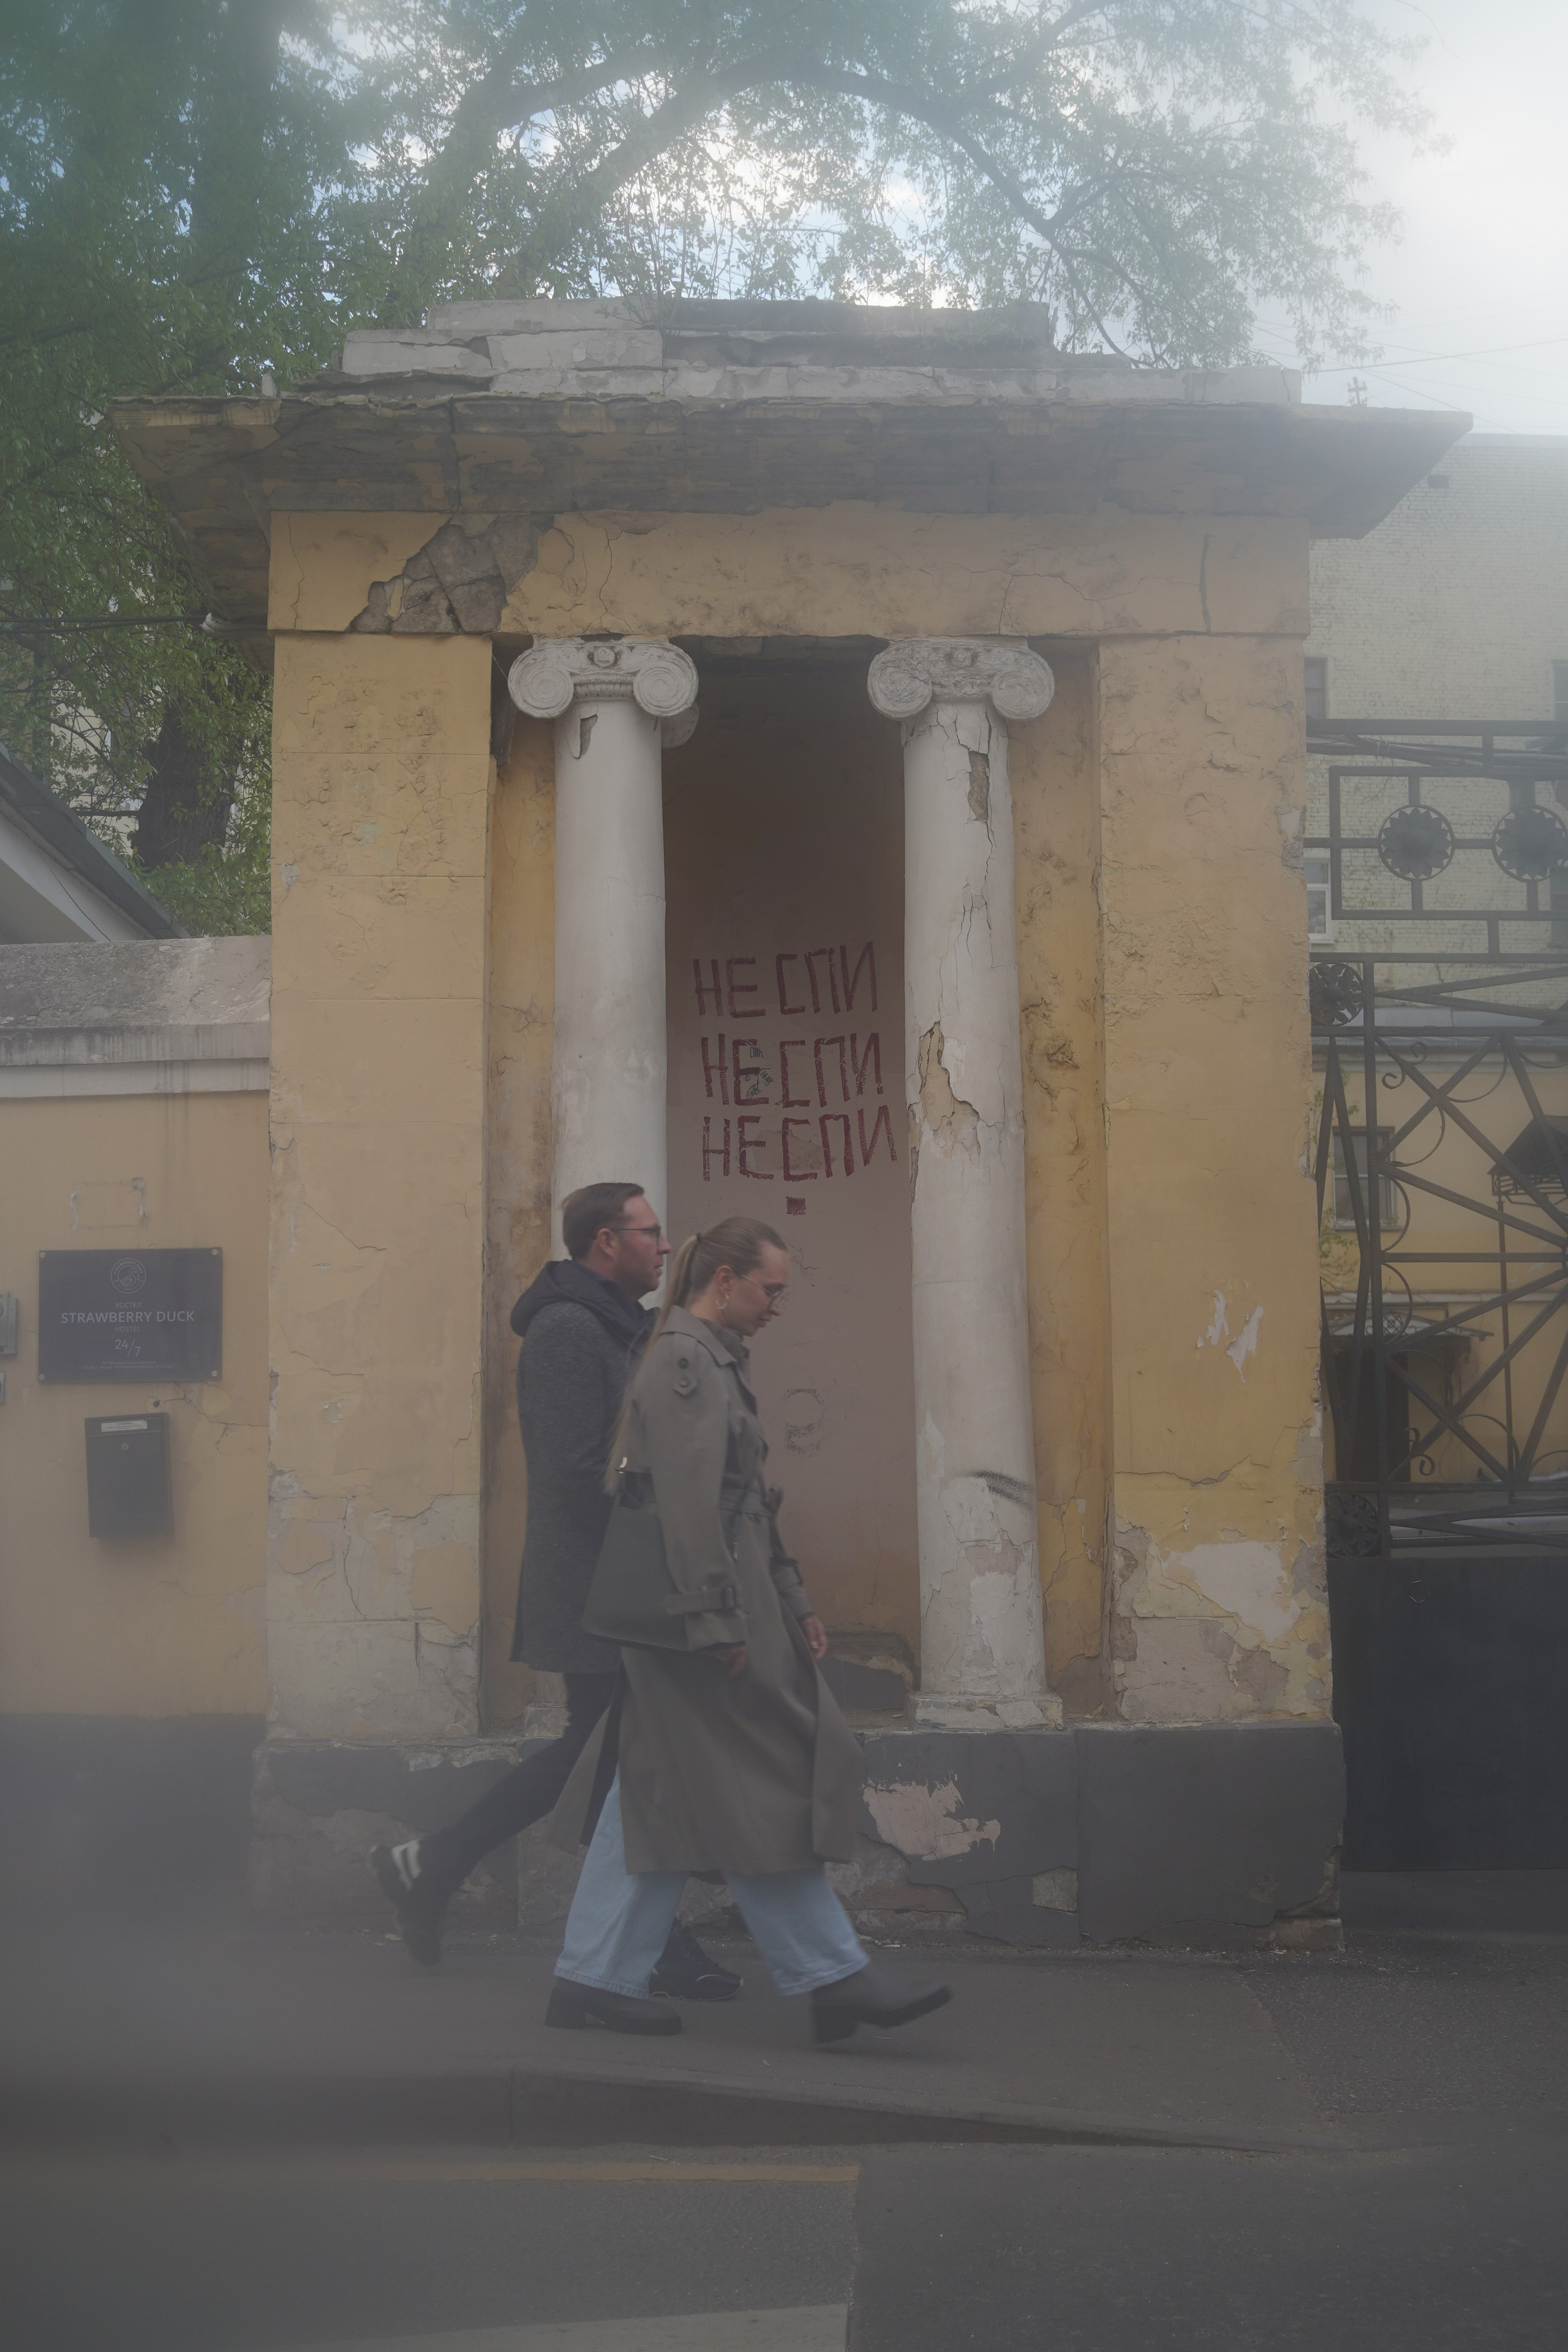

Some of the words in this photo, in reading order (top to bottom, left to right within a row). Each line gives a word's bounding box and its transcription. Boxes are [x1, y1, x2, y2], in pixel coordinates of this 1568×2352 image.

[693, 957, 766, 1018] НЕ
[775, 941, 878, 1015] СПИ
[61, 1311, 153, 1324] STRAWBERRY
[156, 1310, 195, 1322] DUCK
[115, 1337, 141, 1359] 24/7
